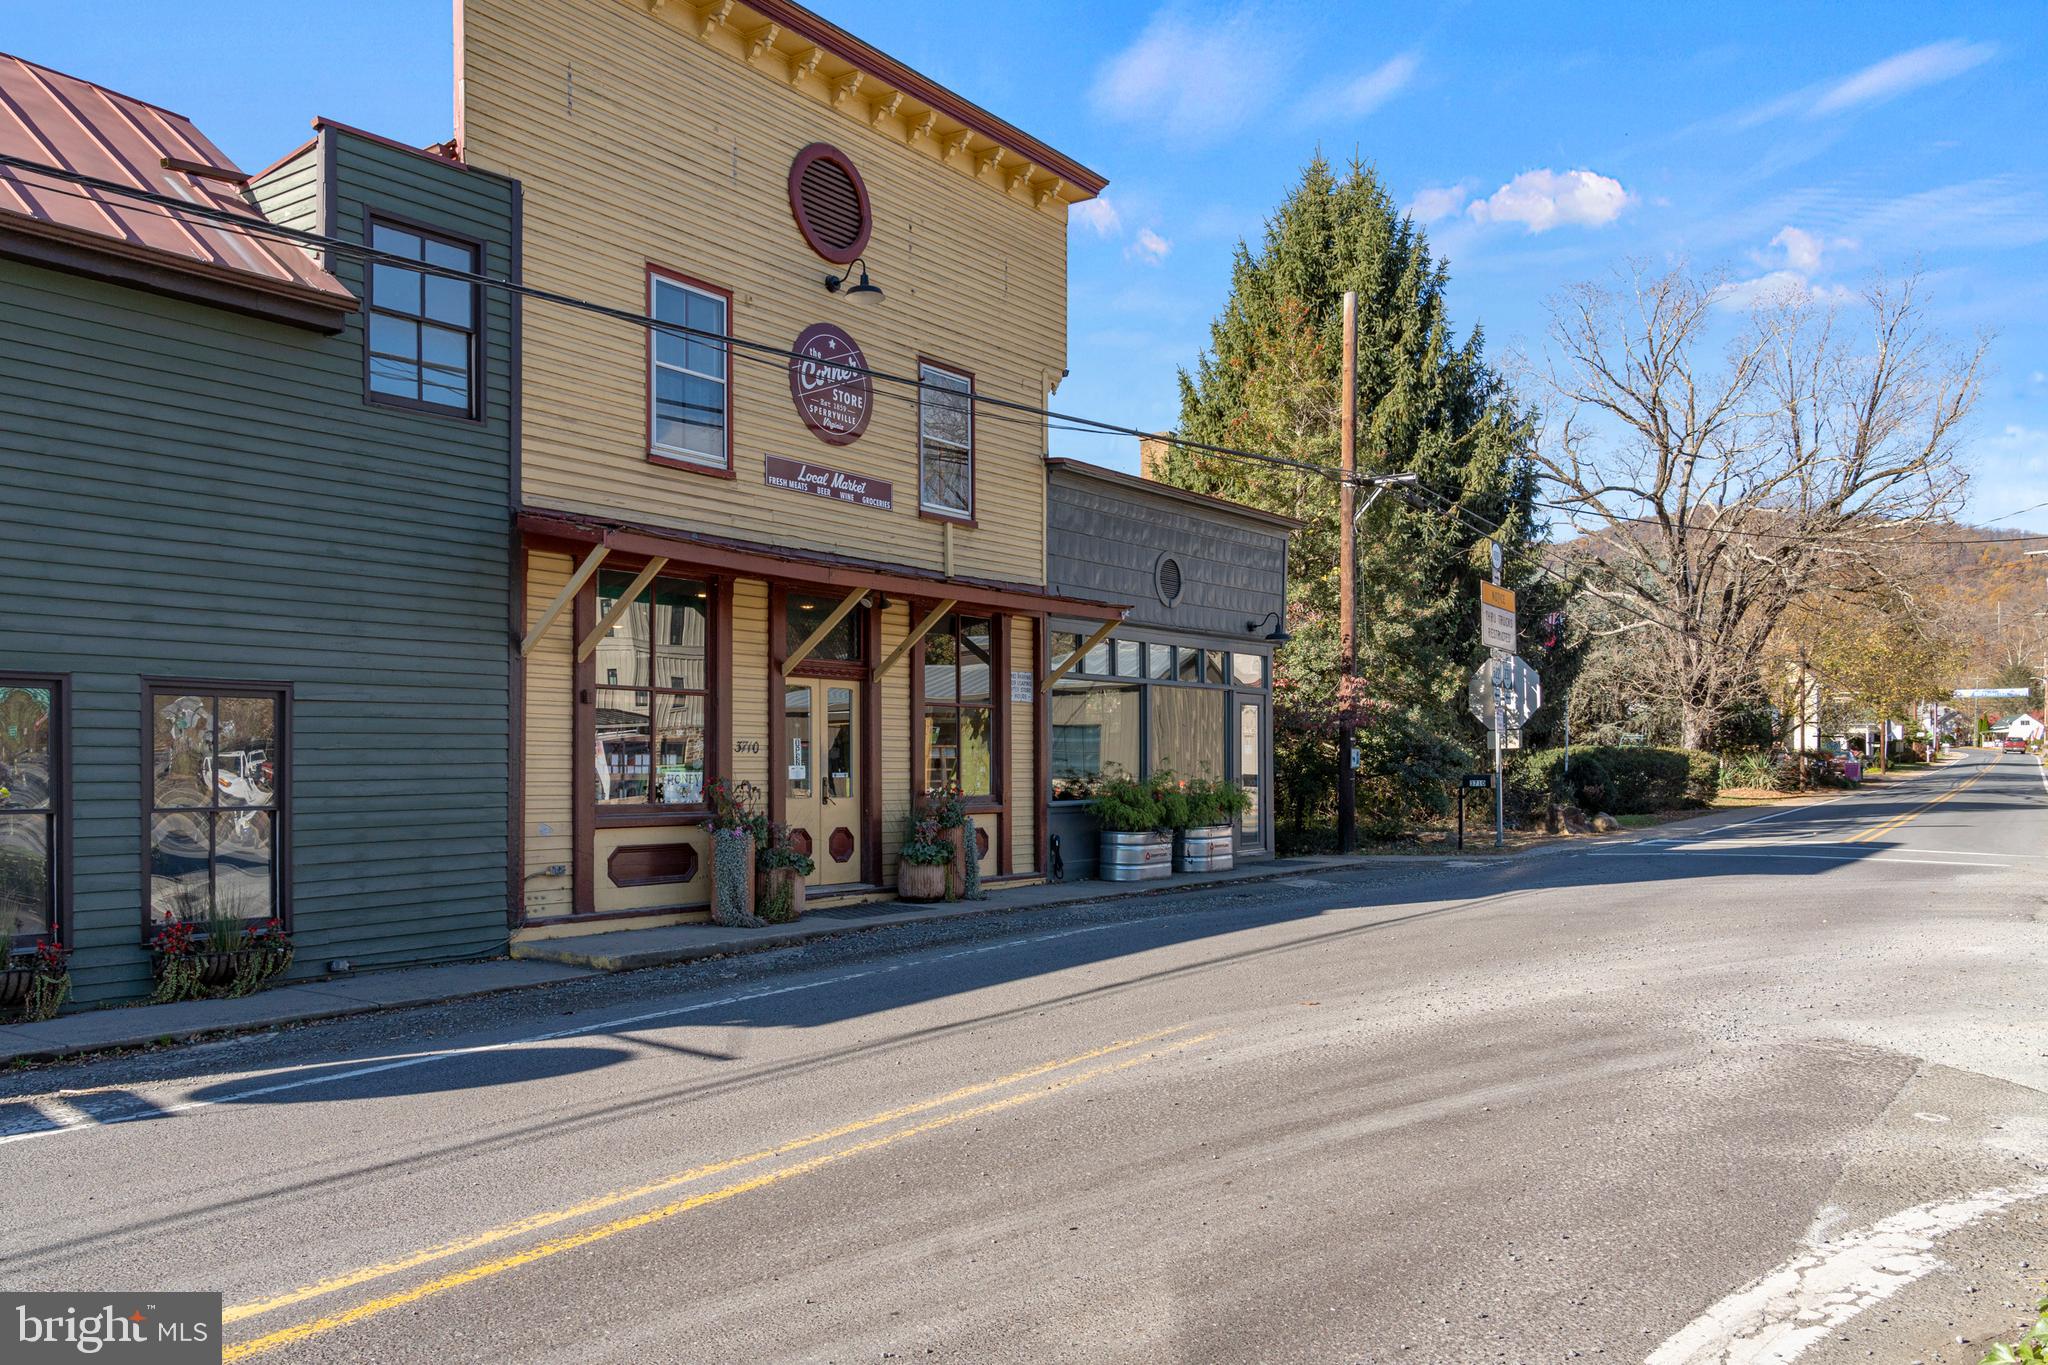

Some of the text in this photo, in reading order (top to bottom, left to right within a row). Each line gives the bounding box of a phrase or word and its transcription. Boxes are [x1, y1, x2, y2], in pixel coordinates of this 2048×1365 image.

[809, 347, 822, 359] the
[801, 357, 858, 390] Corner
[832, 388, 863, 409] STORE
[809, 404, 856, 425] SPERRYVILLE
[822, 417, 845, 431] Virginia
[798, 465, 867, 494] Local Market
[768, 476, 891, 509] FRESH MEATS BEER WINE GROCERIES
[734, 740, 760, 754] 3710
[667, 773, 702, 787] HONEY
[1469, 779, 1487, 787] 3710
